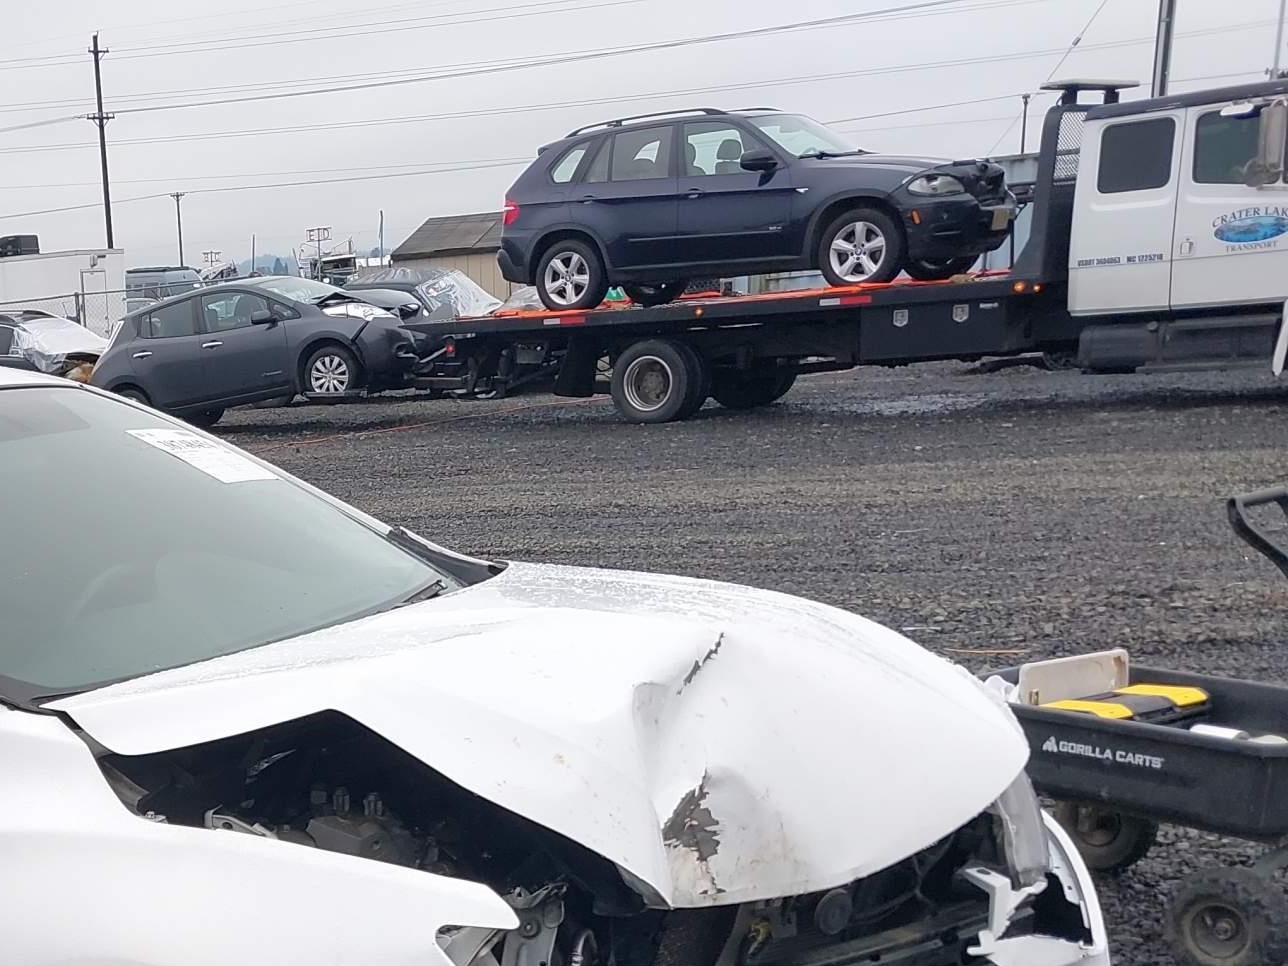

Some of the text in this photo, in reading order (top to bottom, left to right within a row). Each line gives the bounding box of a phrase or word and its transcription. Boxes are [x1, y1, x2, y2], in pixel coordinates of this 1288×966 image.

[1212, 207, 1260, 227] CRATER
[1226, 240, 1278, 253] TRANSPORT
[1059, 741, 1162, 769] GORILLA CARTS
